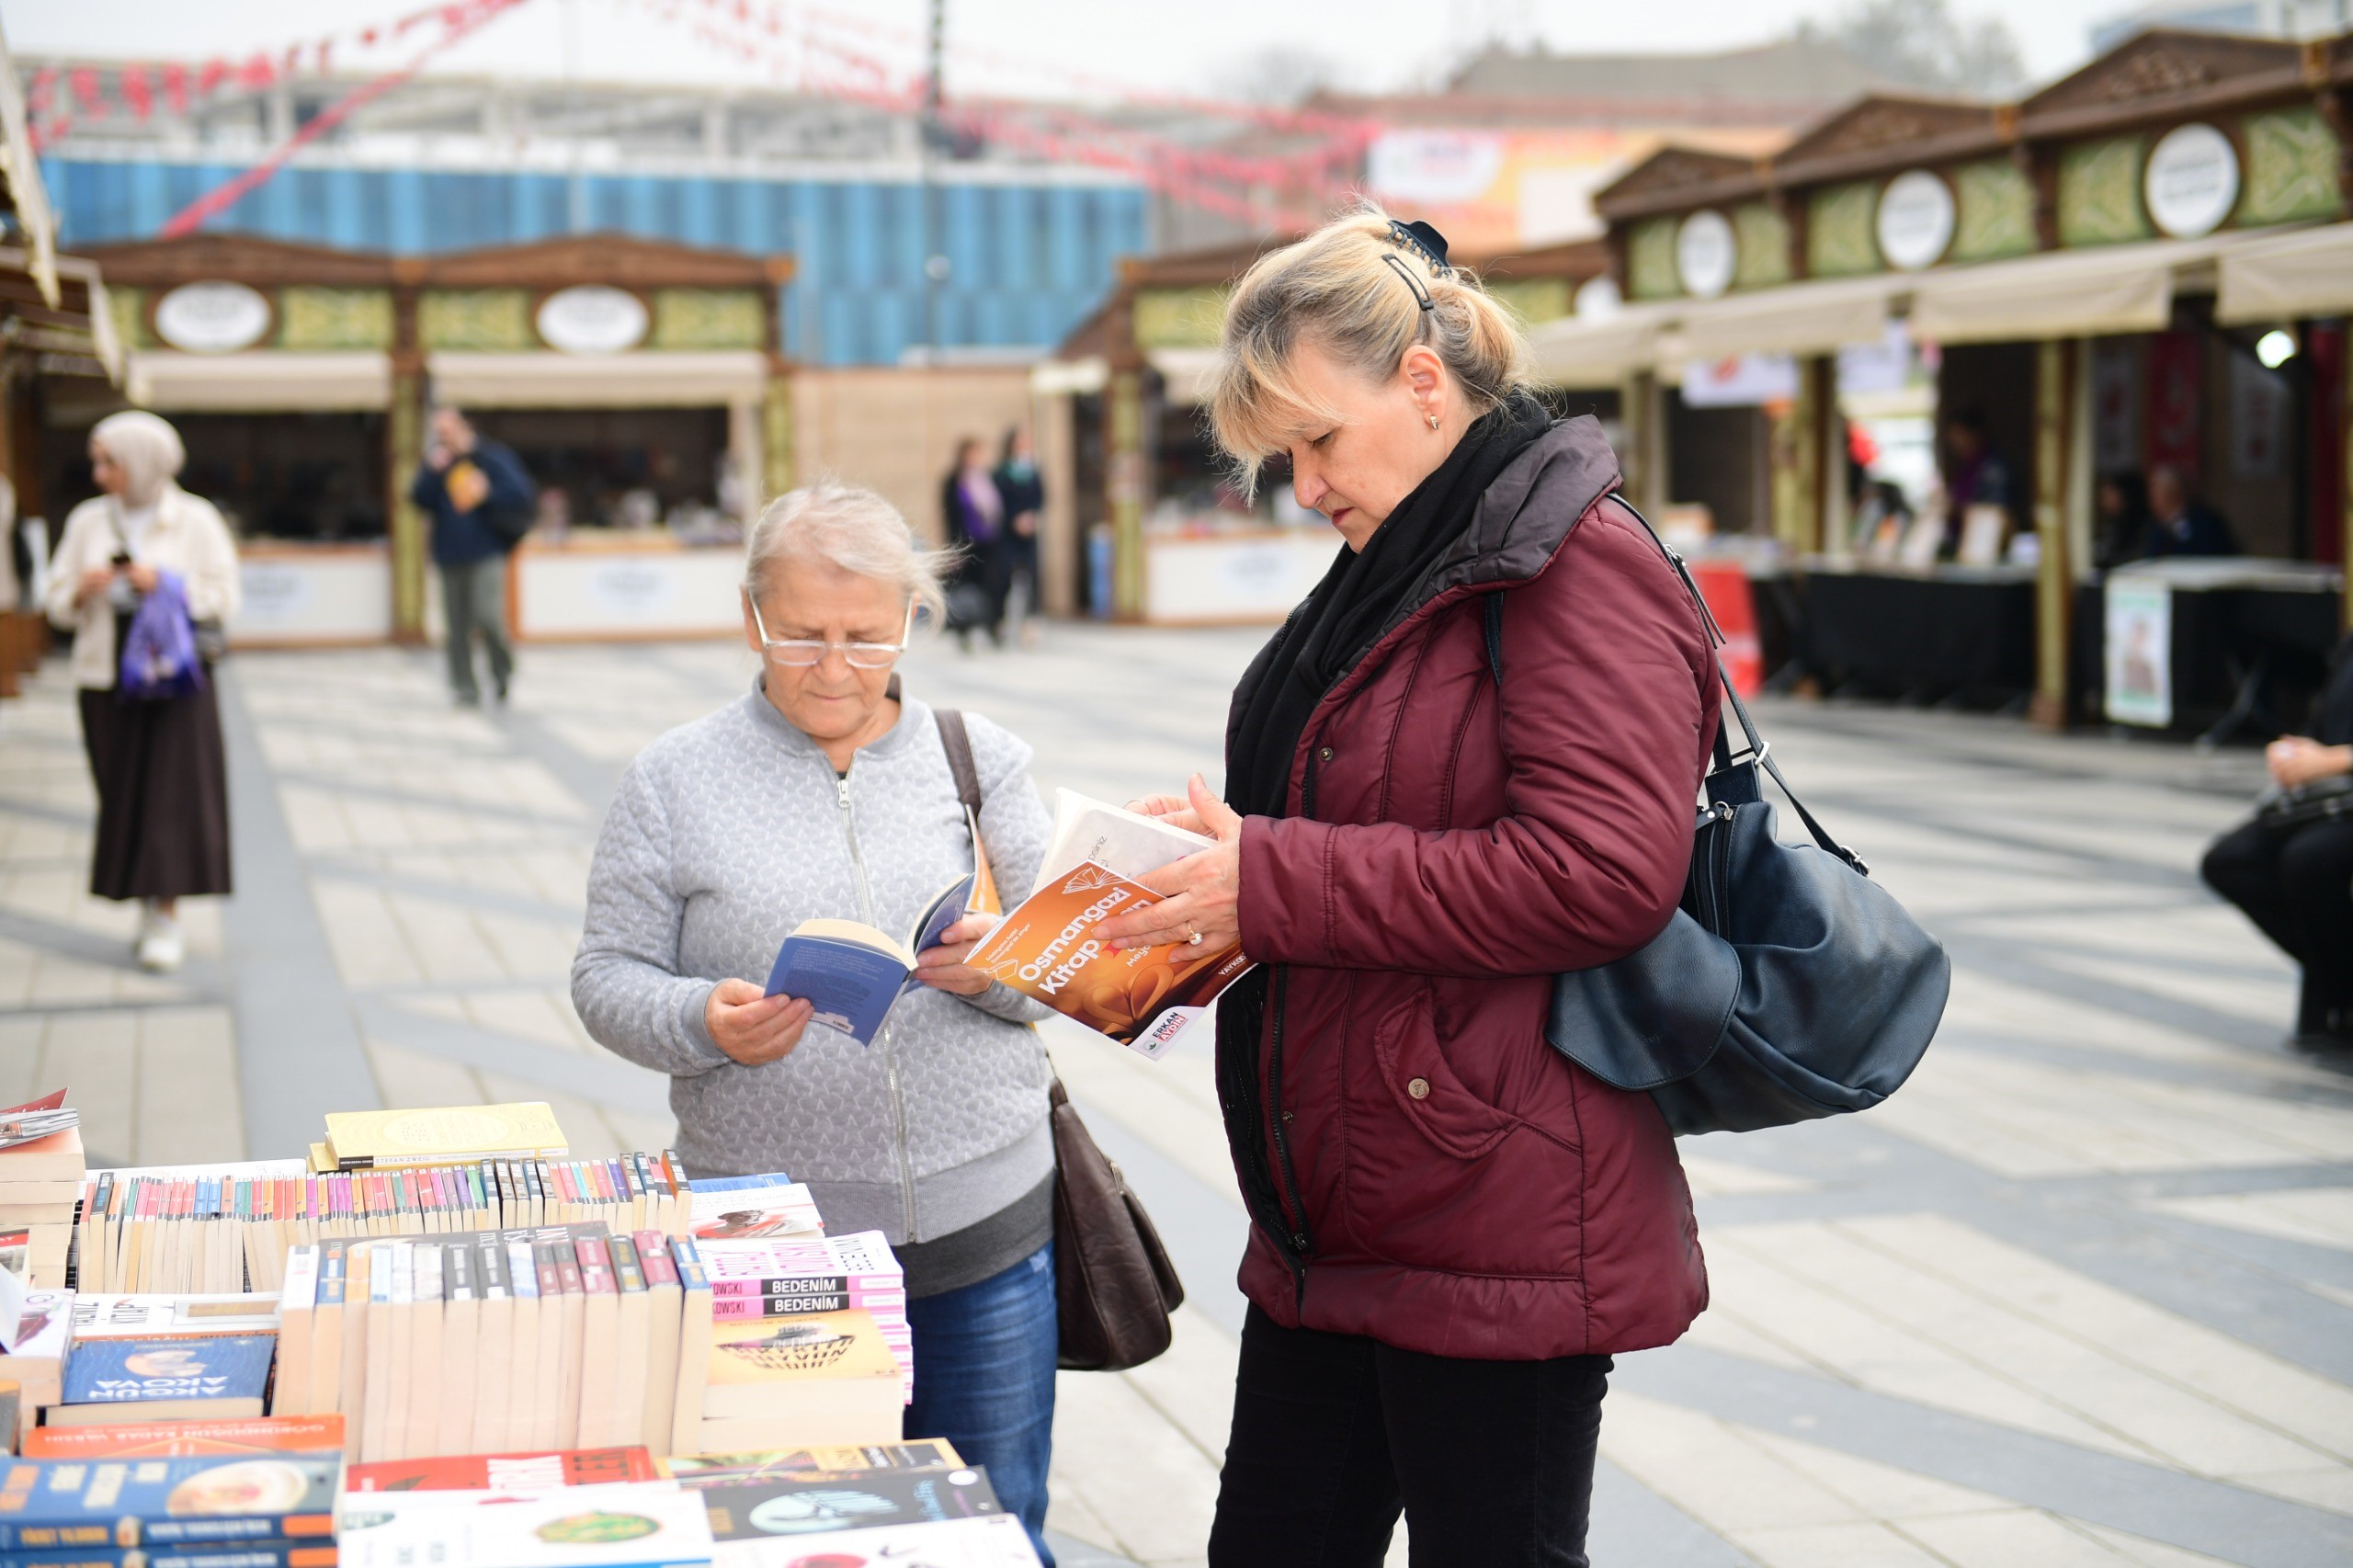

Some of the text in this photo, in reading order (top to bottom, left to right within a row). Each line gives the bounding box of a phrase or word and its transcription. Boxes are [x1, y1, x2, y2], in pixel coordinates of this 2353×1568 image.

[1018, 887, 1131, 981] Osmangazi
[1038, 939, 1100, 995] Kitap
[1152, 1011, 1179, 1039] ERKAN
[1159, 1016, 1187, 1041] AYDIN
[375, 1156, 404, 1165] STEFAN
[710, 1277, 836, 1295] OWSKI BEDENİM
[775, 1295, 838, 1312] BEDENİM
[96, 1376, 228, 1389] AKOVA
